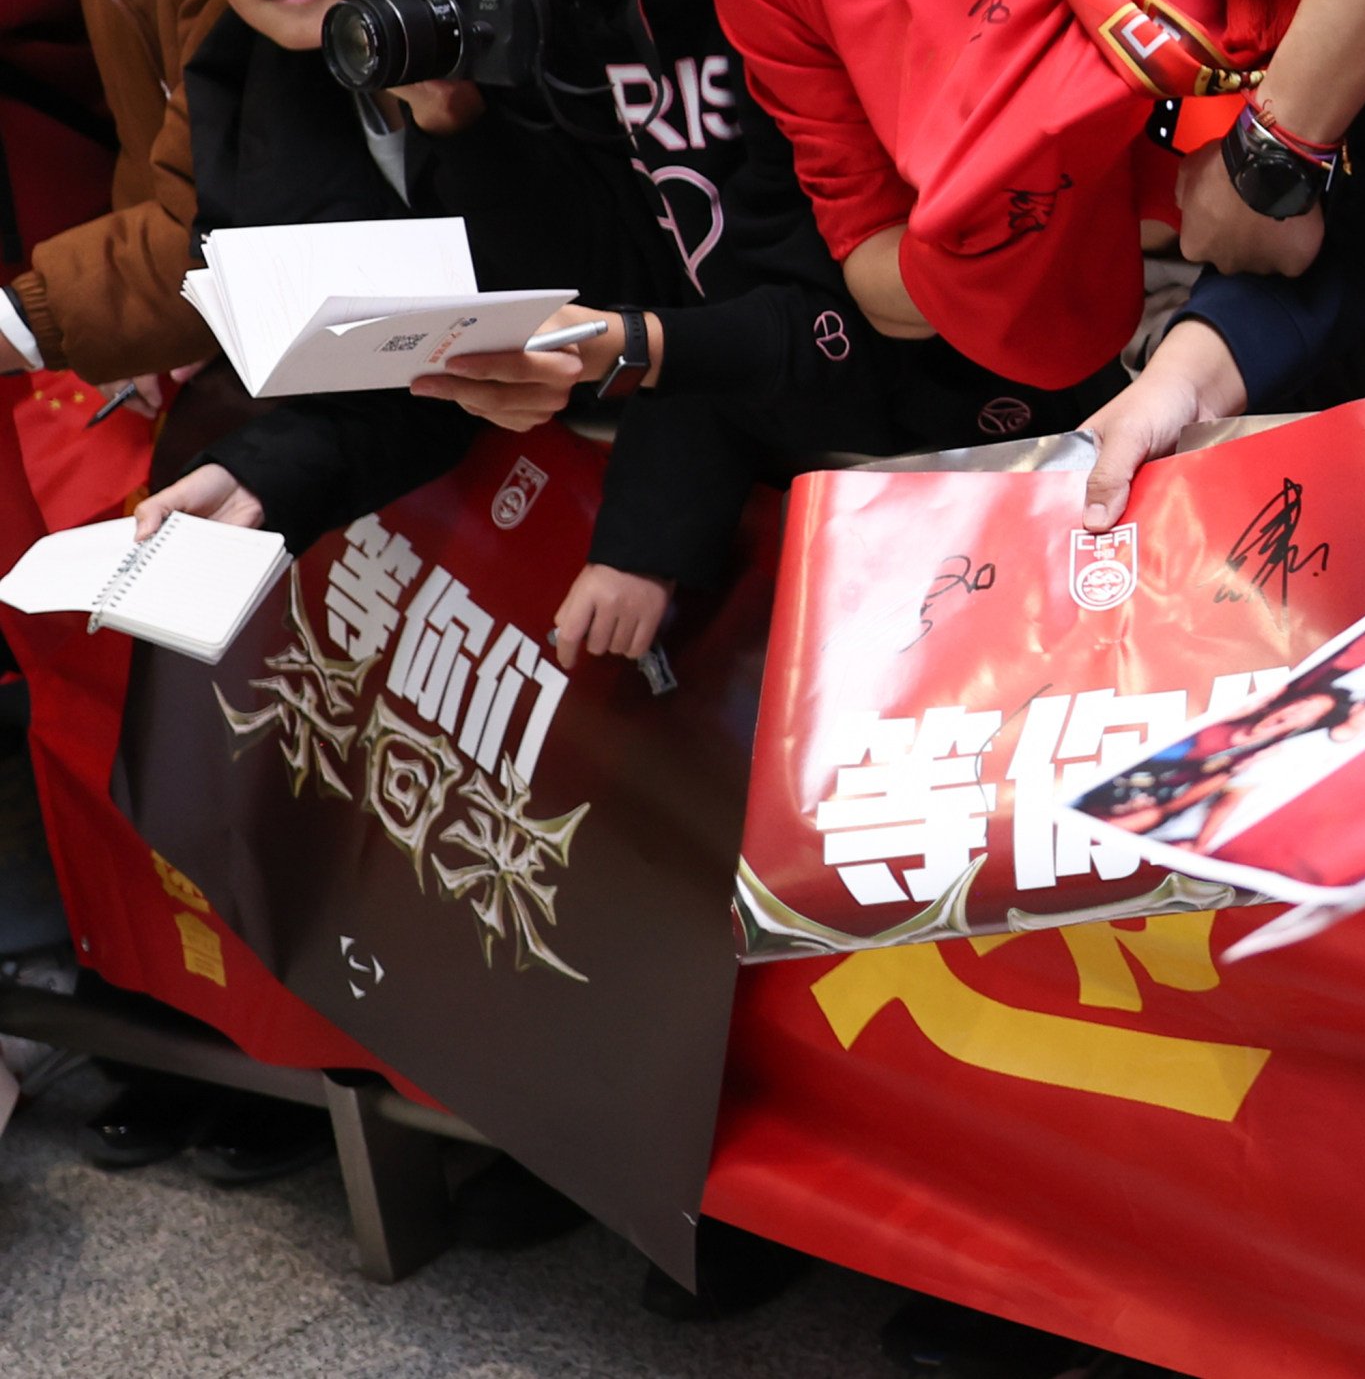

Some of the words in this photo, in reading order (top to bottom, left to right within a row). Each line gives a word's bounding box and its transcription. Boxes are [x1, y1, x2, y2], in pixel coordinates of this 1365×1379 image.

[1077, 529, 1131, 550] CFA
[324, 512, 570, 787] 等你们
